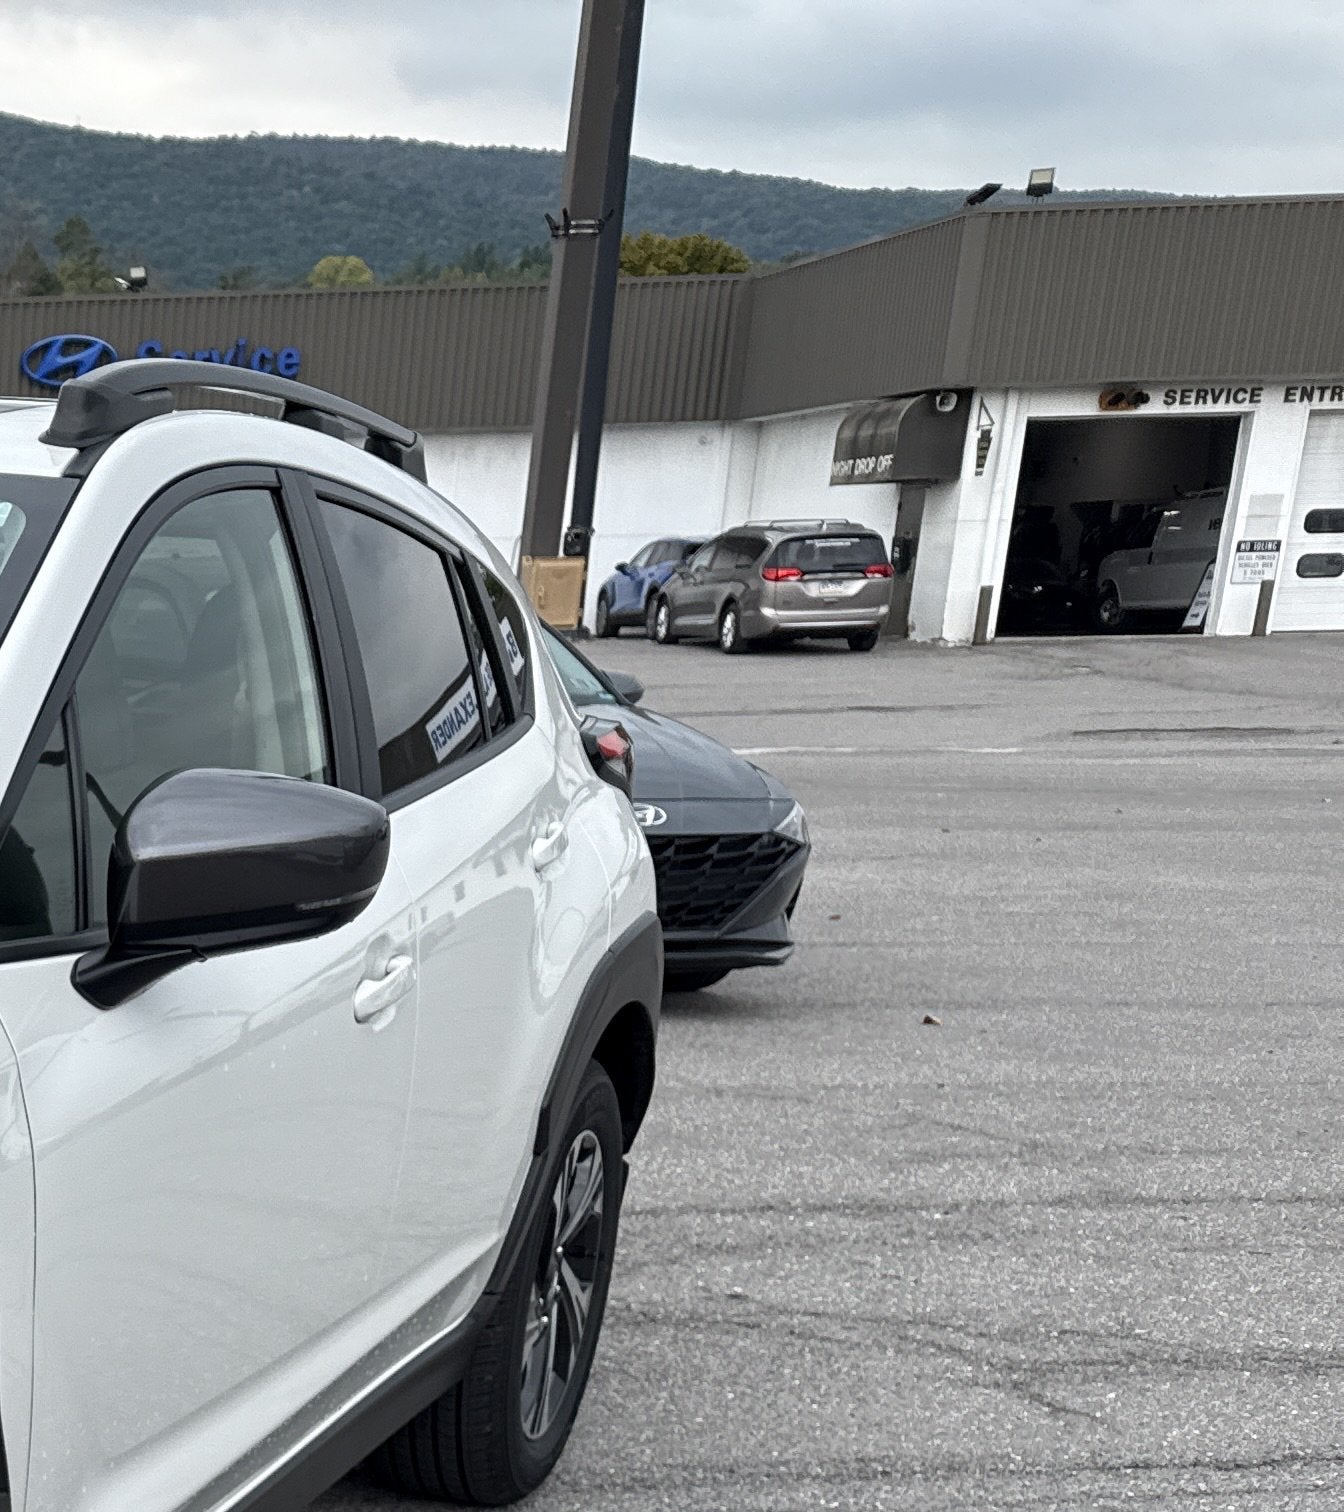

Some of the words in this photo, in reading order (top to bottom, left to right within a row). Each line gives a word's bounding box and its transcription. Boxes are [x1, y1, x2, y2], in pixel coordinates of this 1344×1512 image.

[1163, 386, 1264, 406] SERVICE
[854, 456, 876, 475] DROP
[877, 454, 894, 472] OFF
